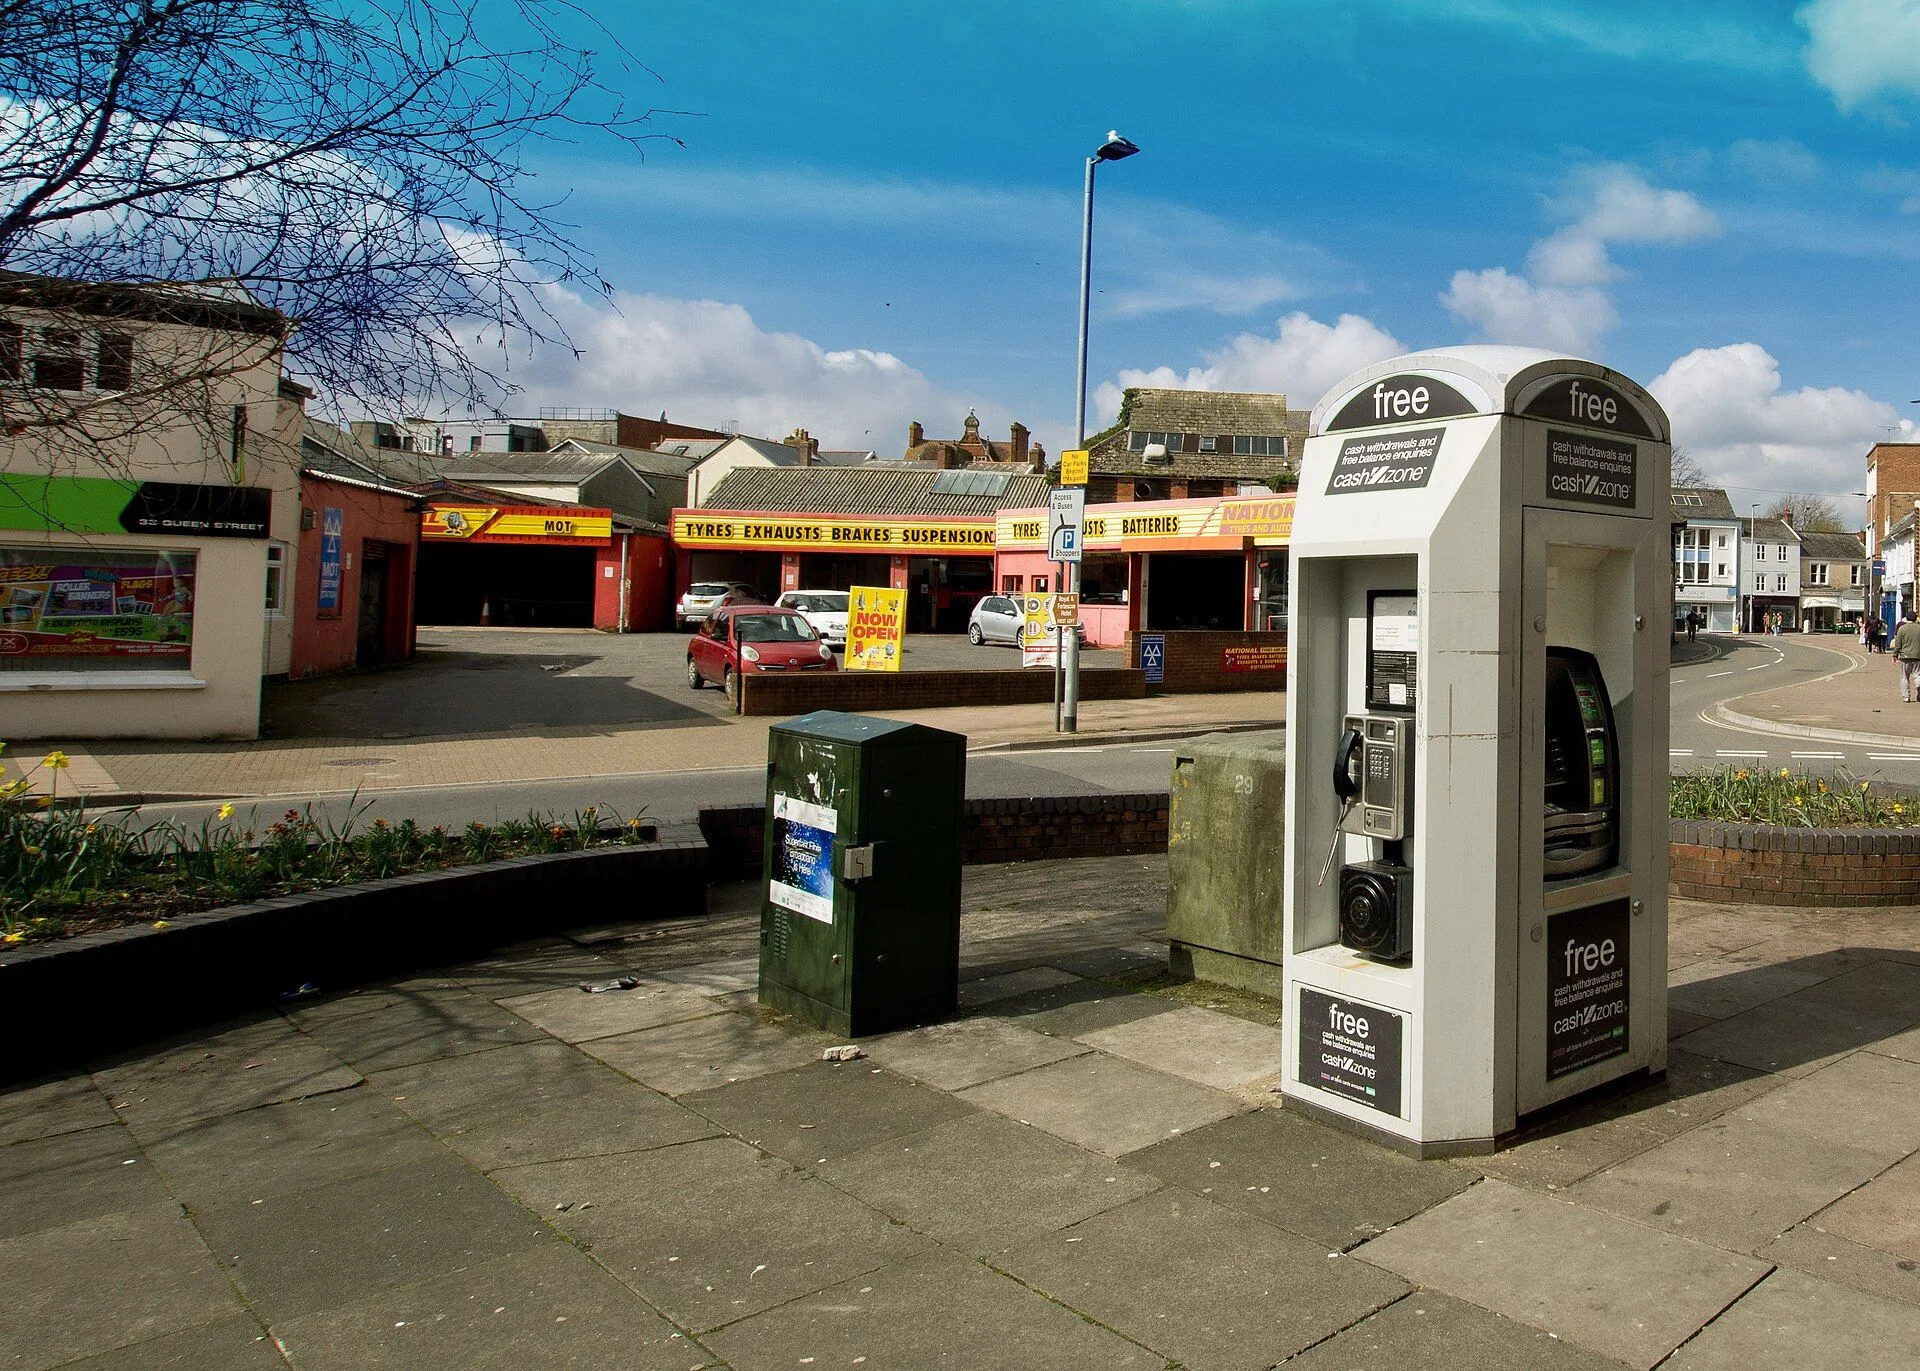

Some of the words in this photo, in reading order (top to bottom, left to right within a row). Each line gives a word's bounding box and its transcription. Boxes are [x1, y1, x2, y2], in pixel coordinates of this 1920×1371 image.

[1373, 383, 1430, 419] free
[1569, 382, 1618, 424] free
[1344, 443, 1366, 456] cash
[1367, 438, 1418, 453] withdrawals
[1419, 435, 1438, 449] and
[1552, 440, 1573, 454] cash
[1573, 442, 1613, 460] withdrawals
[1615, 449, 1632, 463] and
[1341, 455, 1358, 466] free
[1358, 451, 1391, 464] balance
[1392, 446, 1433, 462] enquiries
[1066, 468, 1084, 476] Beyond
[1552, 454, 1568, 465] free
[1568, 454, 1599, 469] balance
[1599, 460, 1632, 475] enquiries
[1063, 474, 1072, 482] this
[1073, 474, 1086, 482] point
[1057, 502, 1073, 510] Buses
[162, 519, 210, 528] QUEEN
[213, 521, 265, 531] STREET
[544, 520, 572, 532] MOT
[686, 523, 733, 537] TYRES
[744, 523, 821, 540] EXHAUSTS
[831, 527, 890, 542] BRAKES
[1013, 523, 1040, 538] TYRES
[1122, 517, 1179, 535] BATTERIES
[1230, 524, 1250, 533] TYRES
[1252, 523, 1269, 533] AND
[1064, 532, 1073, 548] P
[1055, 549, 1080, 558] Shoppers
[323, 563, 340, 577] MOT
[55, 582, 91, 593] ROLLER
[120, 579, 153, 590] FLAGS
[68, 590, 112, 600] BANNERS
[856, 612, 898, 627] NOW
[113, 626, 143, 637] £595
[852, 625, 899, 641] OPEN
[789, 850, 816, 865] Broadband
[799, 864, 812, 876] Here
[1564, 938, 1616, 977] free
[1554, 981, 1571, 997] cash
[1571, 973, 1611, 993] withdrawals
[1610, 967, 1624, 980] and
[1554, 994, 1568, 1008] free
[1568, 988, 1595, 1004] balance
[1594, 978, 1624, 997] enquiries
[1328, 1003, 1369, 1039] free
[1322, 1031, 1335, 1040] cash
[1335, 1035, 1365, 1050] withdrawals
[1365, 1043, 1376, 1053] and
[1322, 1037, 1332, 1047] free
[1332, 1040, 1352, 1053] balance
[1352, 1047, 1376, 1060] enquiries
